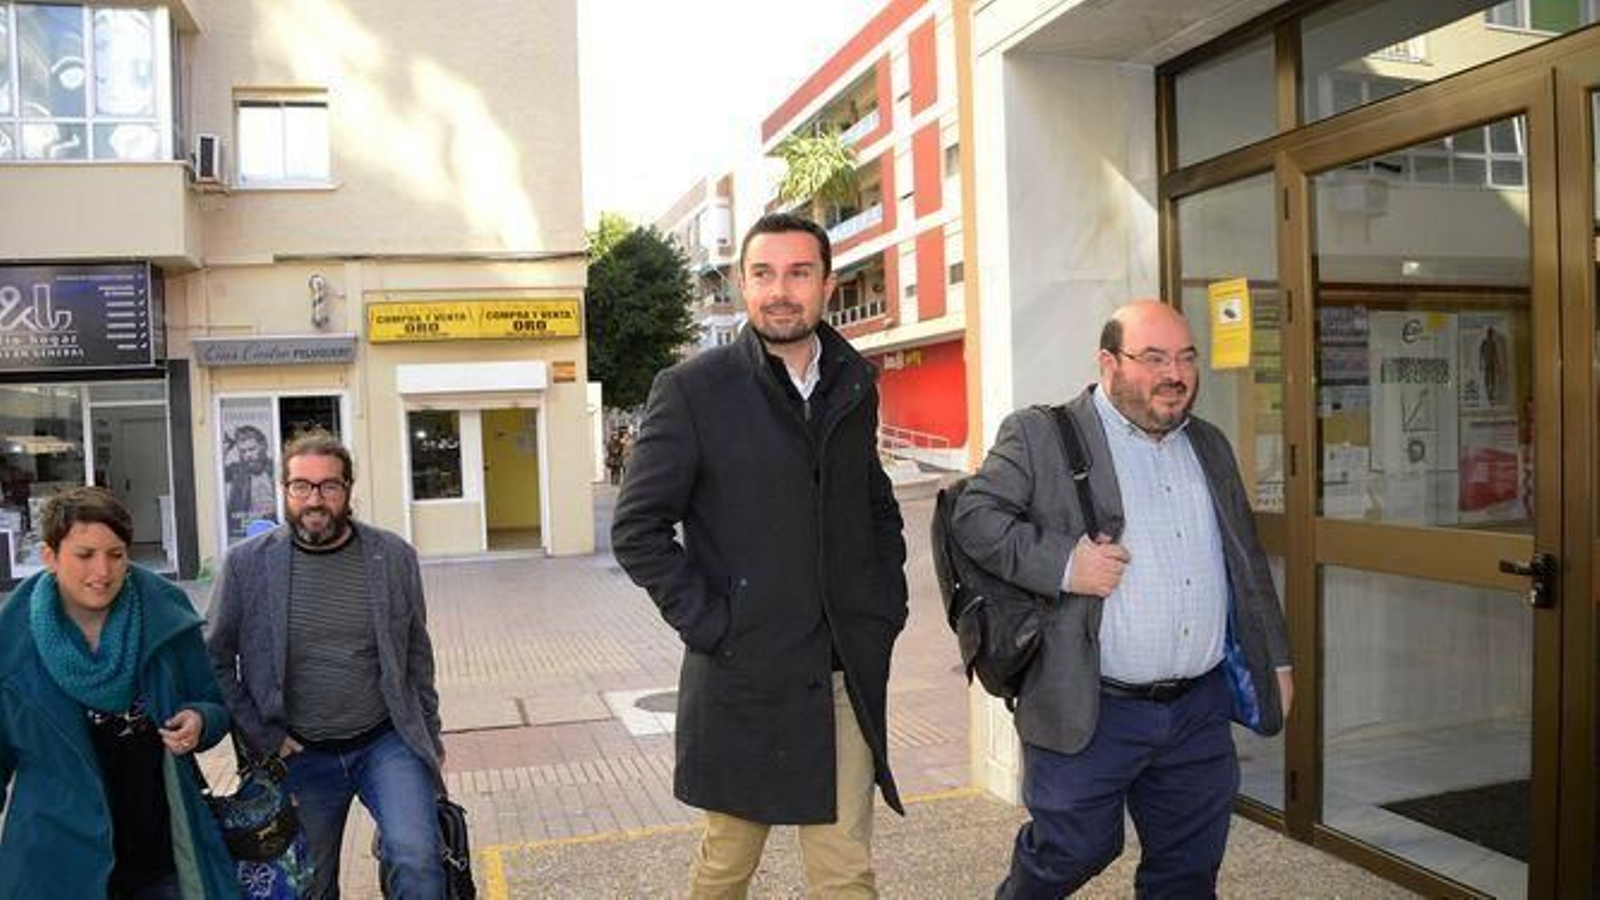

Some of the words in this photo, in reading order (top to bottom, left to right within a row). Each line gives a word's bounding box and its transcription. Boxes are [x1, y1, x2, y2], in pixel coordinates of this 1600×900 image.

[376, 314, 422, 324] COMPRA
[486, 310, 530, 320] COMPRA
[541, 309, 572, 320] VENTA
[404, 323, 439, 334] ORO
[513, 320, 547, 332] ORO
